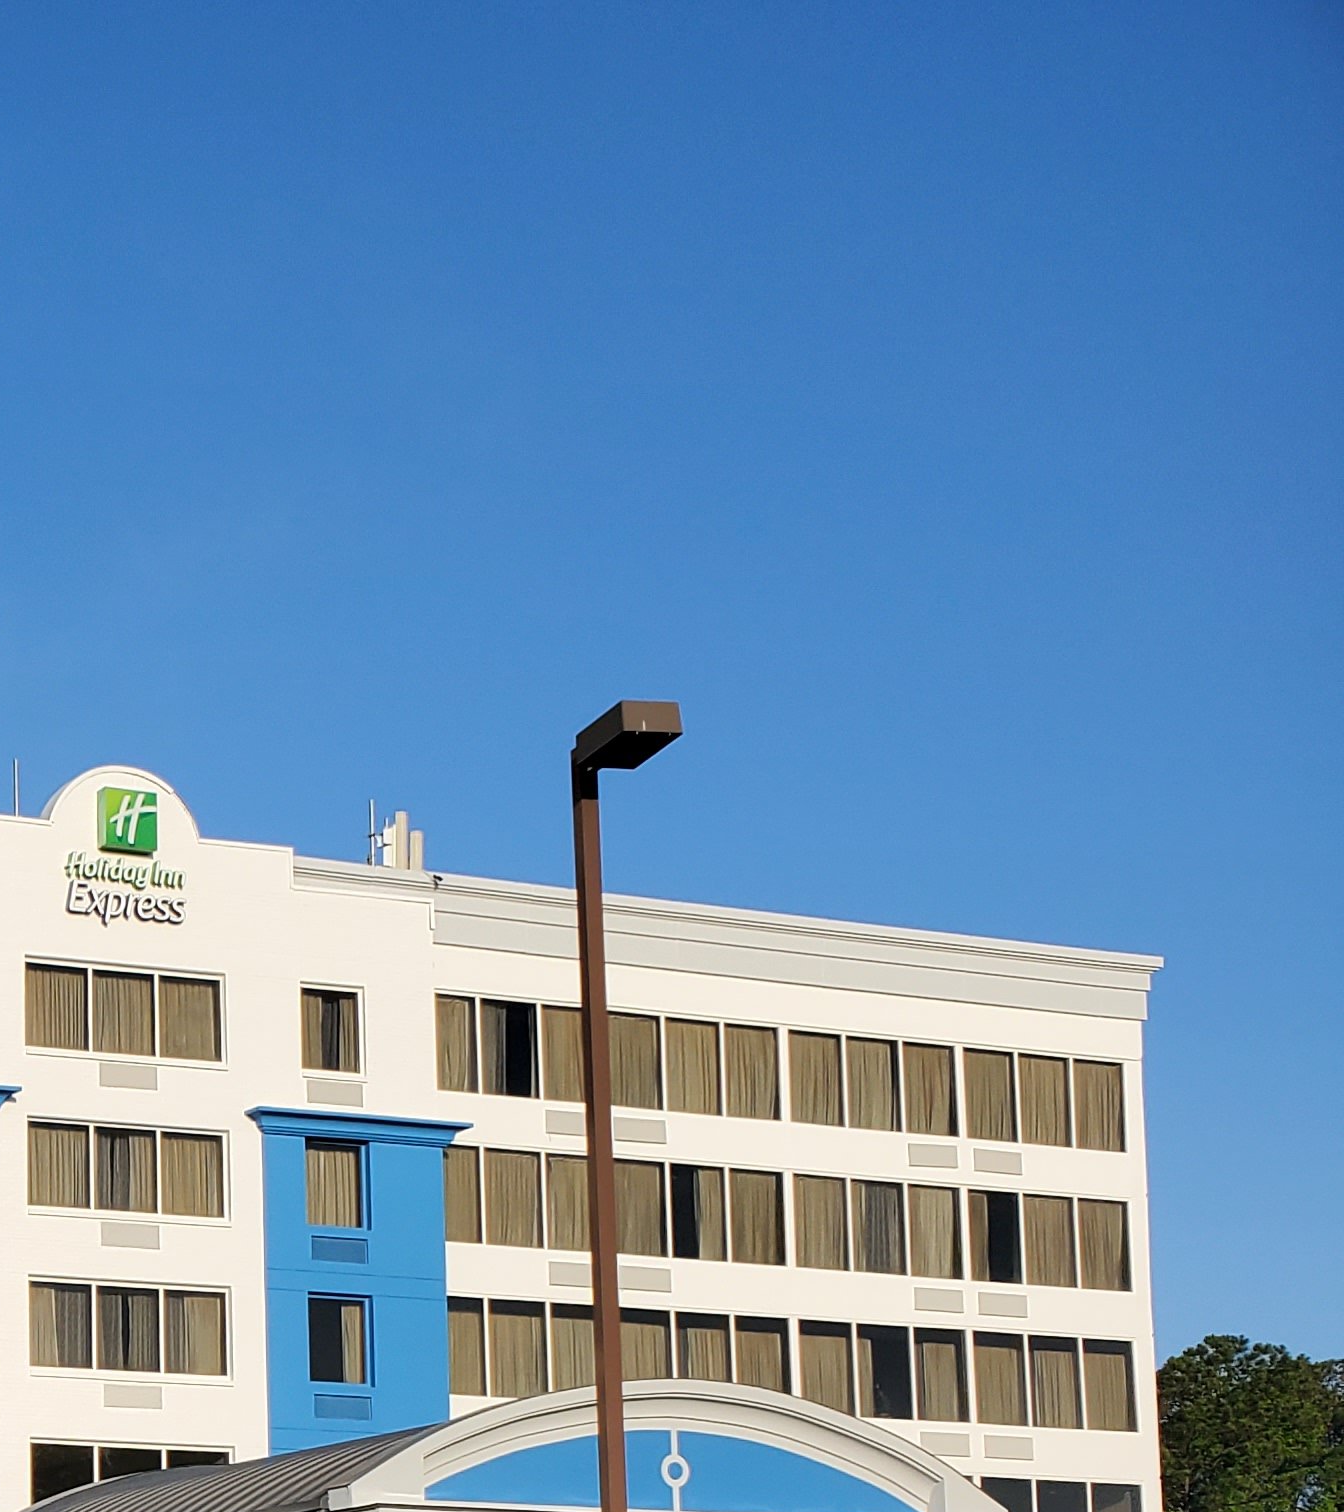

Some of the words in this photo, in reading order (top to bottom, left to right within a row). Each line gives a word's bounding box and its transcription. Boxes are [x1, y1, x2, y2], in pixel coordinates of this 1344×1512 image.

[65, 851, 150, 889] Holiday
[151, 861, 186, 890] Inn
[65, 879, 187, 927] Express
